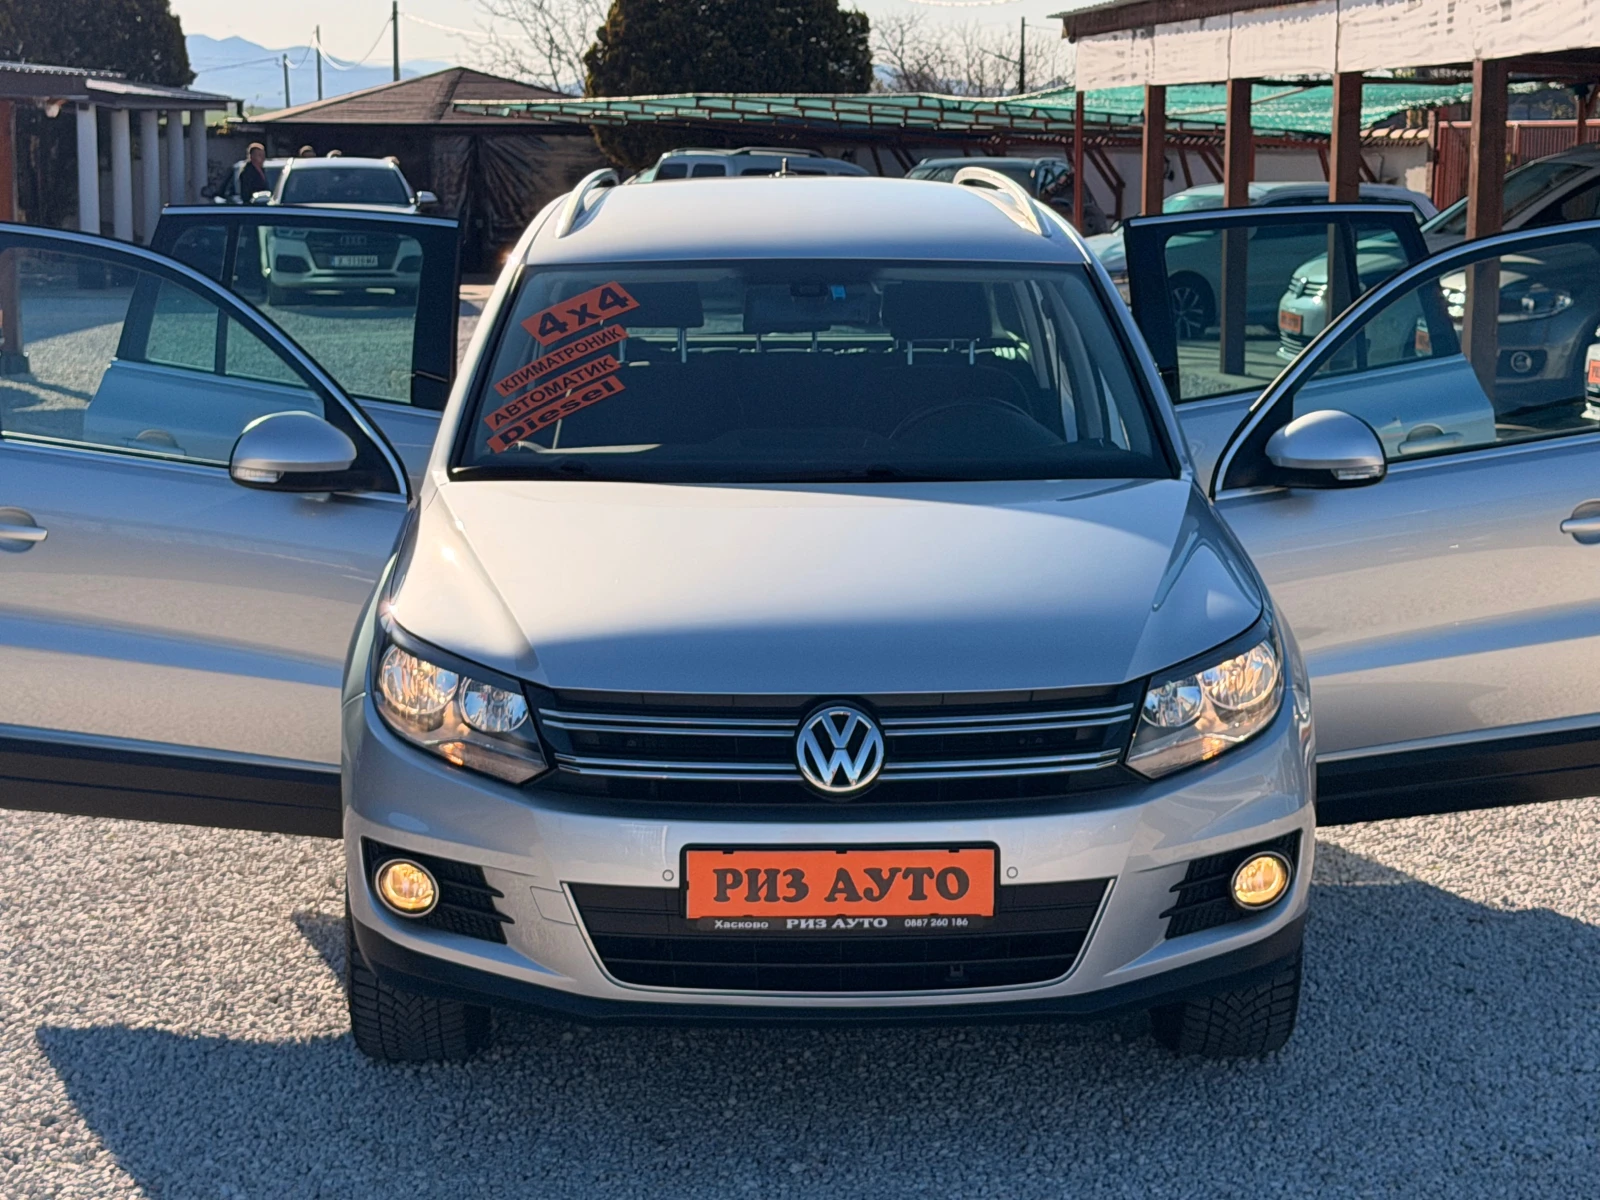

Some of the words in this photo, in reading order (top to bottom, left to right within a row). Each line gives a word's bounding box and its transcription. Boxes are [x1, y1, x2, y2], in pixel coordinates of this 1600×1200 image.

[537, 286, 629, 338] 4x4
[493, 357, 614, 426] АВТОМАТИК
[500, 328, 621, 392] КЛИМАТРОНИК
[498, 380, 616, 445] Diesel
[796, 706, 884, 792] VW
[712, 868, 809, 902] РИЗ
[823, 866, 970, 903] АУТО
[714, 919, 769, 930] Хасково
[786, 918, 827, 930] РИЗ
[831, 917, 888, 929] АУТО
[930, 917, 949, 927] 260
